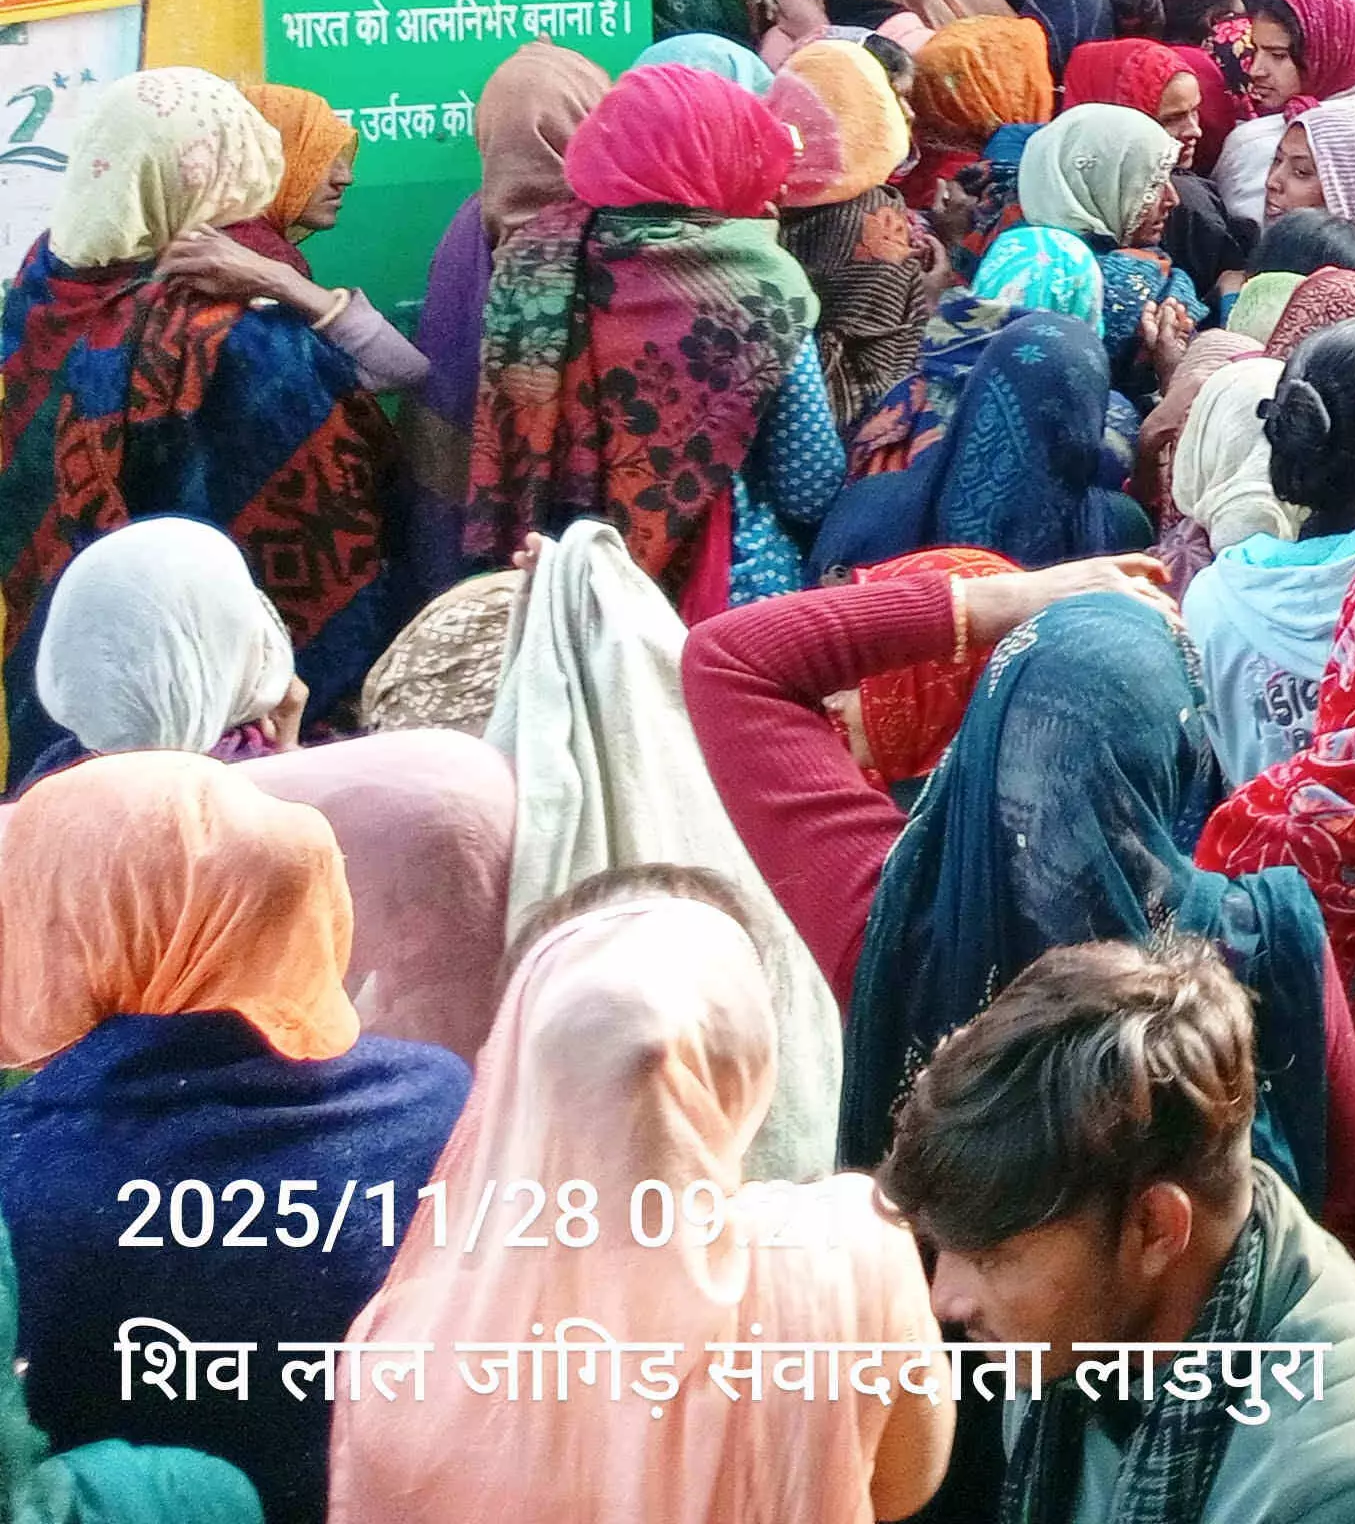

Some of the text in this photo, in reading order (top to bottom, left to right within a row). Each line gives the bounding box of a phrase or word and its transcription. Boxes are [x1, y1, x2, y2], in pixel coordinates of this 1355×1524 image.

[282, 11, 350, 49] भारत
[521, 1, 595, 38] बनाना
[359, 89, 476, 143] उर्वरक को
